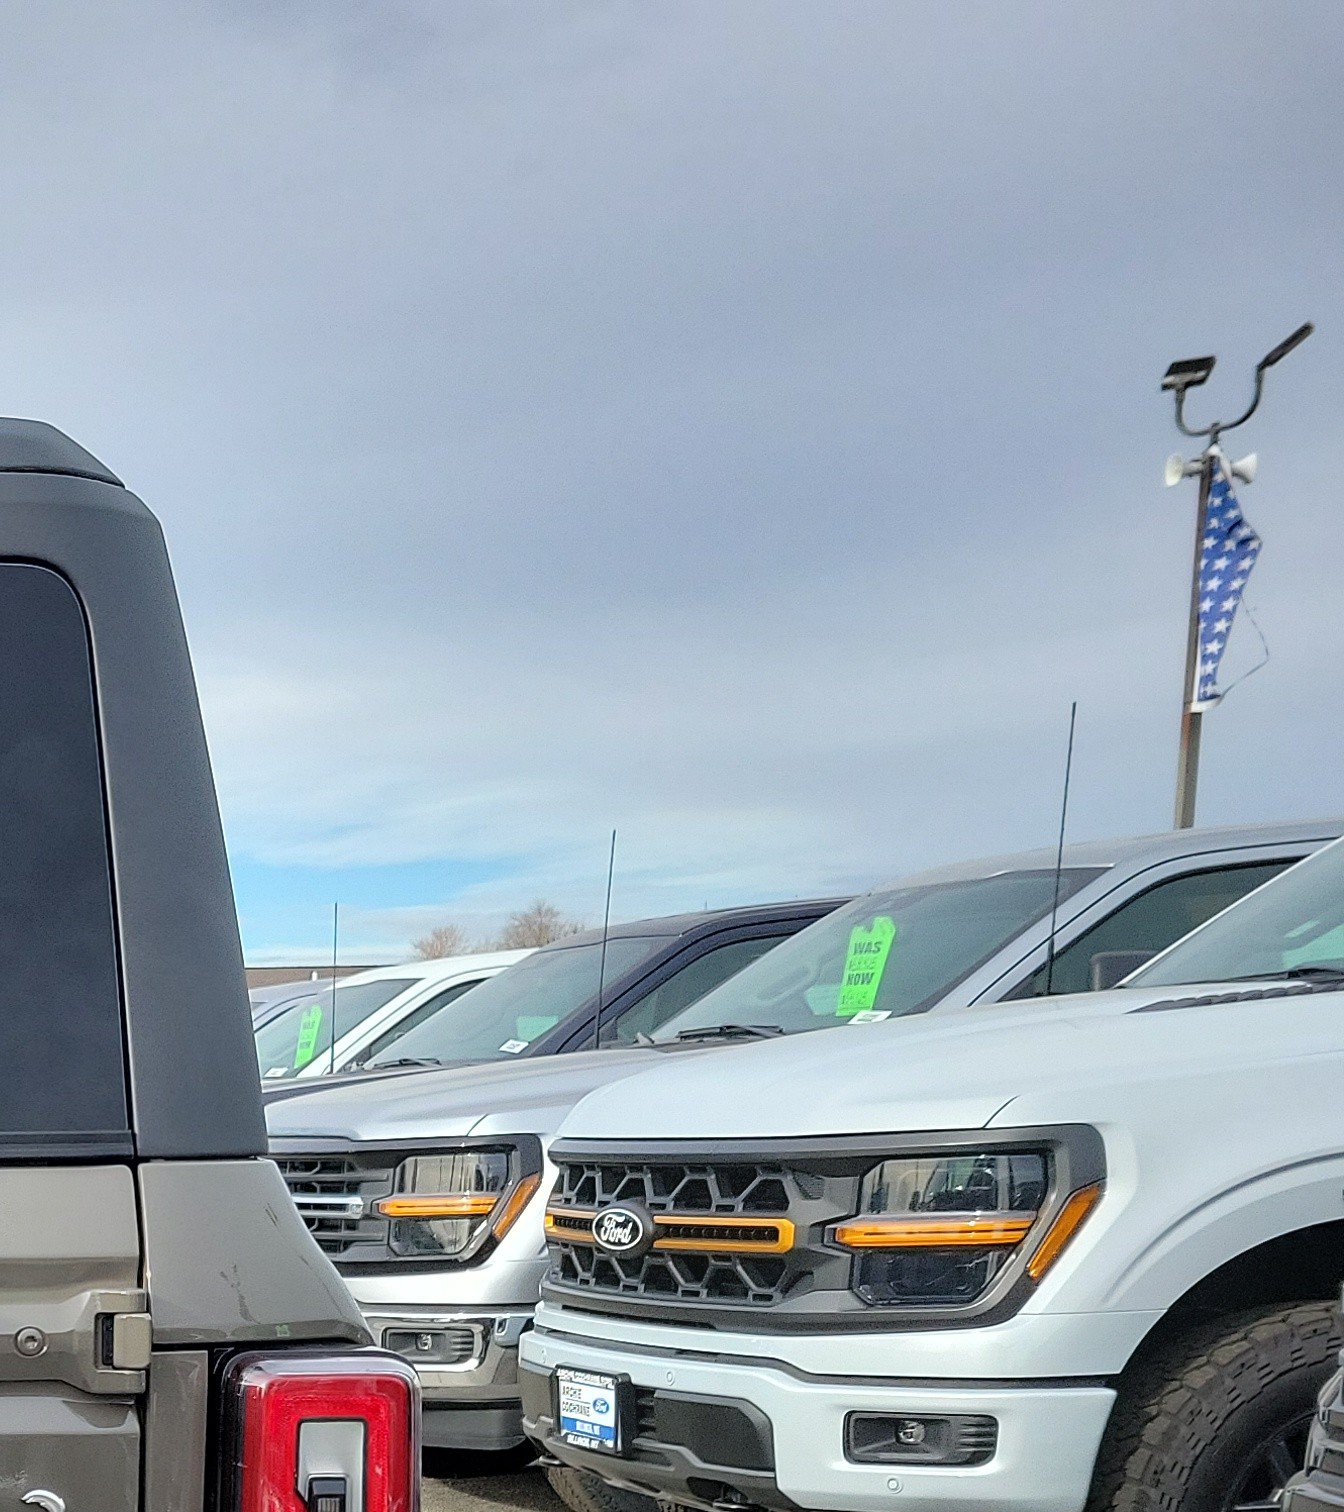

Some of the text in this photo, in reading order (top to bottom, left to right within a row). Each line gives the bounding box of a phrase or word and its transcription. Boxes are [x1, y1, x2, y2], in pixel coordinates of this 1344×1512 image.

[853, 941, 882, 956] WAS
[846, 972, 874, 986] NOW
[600, 1213, 633, 1244] Ford
